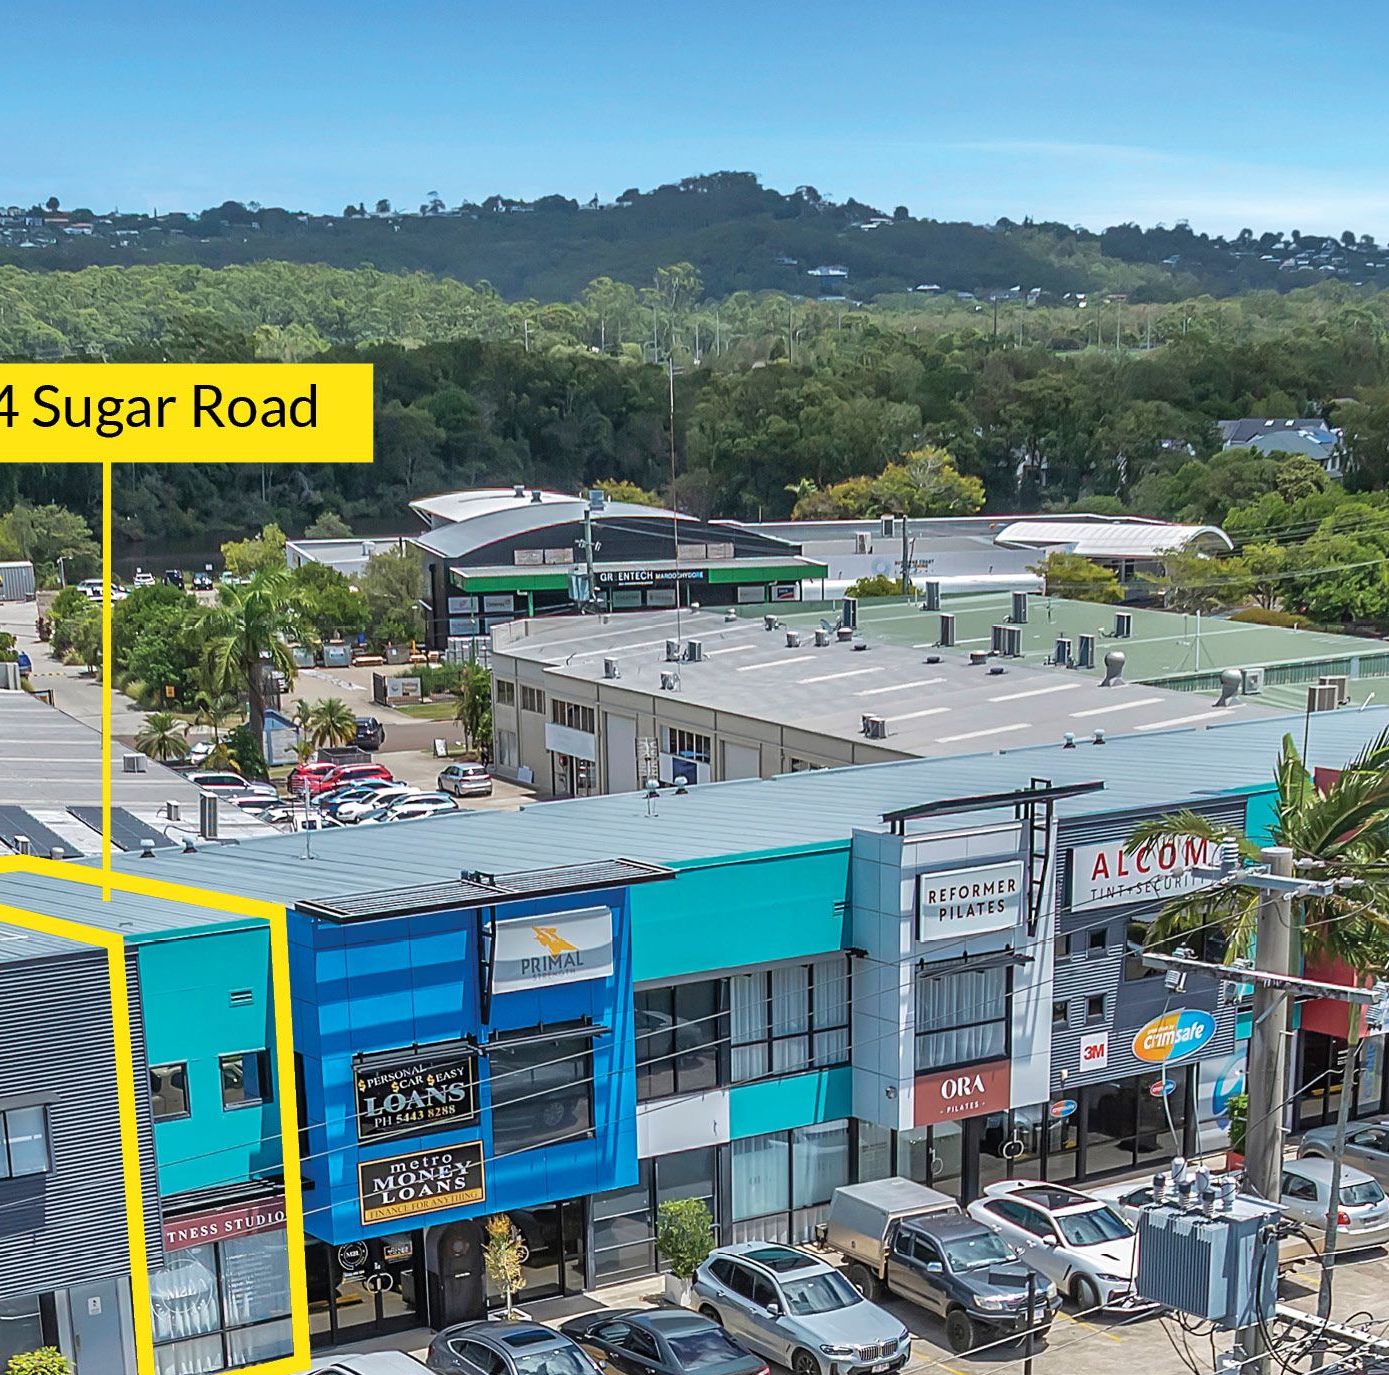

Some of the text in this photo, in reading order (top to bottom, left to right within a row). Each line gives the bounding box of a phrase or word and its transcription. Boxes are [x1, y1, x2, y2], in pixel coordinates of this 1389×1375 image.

[600, 571, 653, 582] GRENTECH
[1091, 837, 1208, 881] ALCOM
[928, 878, 1016, 904] REFORMER
[939, 899, 1005, 922] PILATES
[521, 950, 584, 975] PRIMAL
[1143, 1021, 1205, 1050] crimsafe
[1083, 1043, 1105, 1061] 3M
[364, 1082, 466, 1118] LOANS
[941, 1074, 985, 1100] ORA
[374, 1104, 456, 1128] PH 5443 8288
[947, 1101, 979, 1114] PILATES
[373, 1160, 472, 1193] MONEY
[390, 1153, 453, 1174] metro
[381, 1177, 466, 1204] LOANS
[370, 1191, 479, 1219] FINANCE FOR ANYTHING
[167, 1211, 285, 1243] TNESS STUDIO
